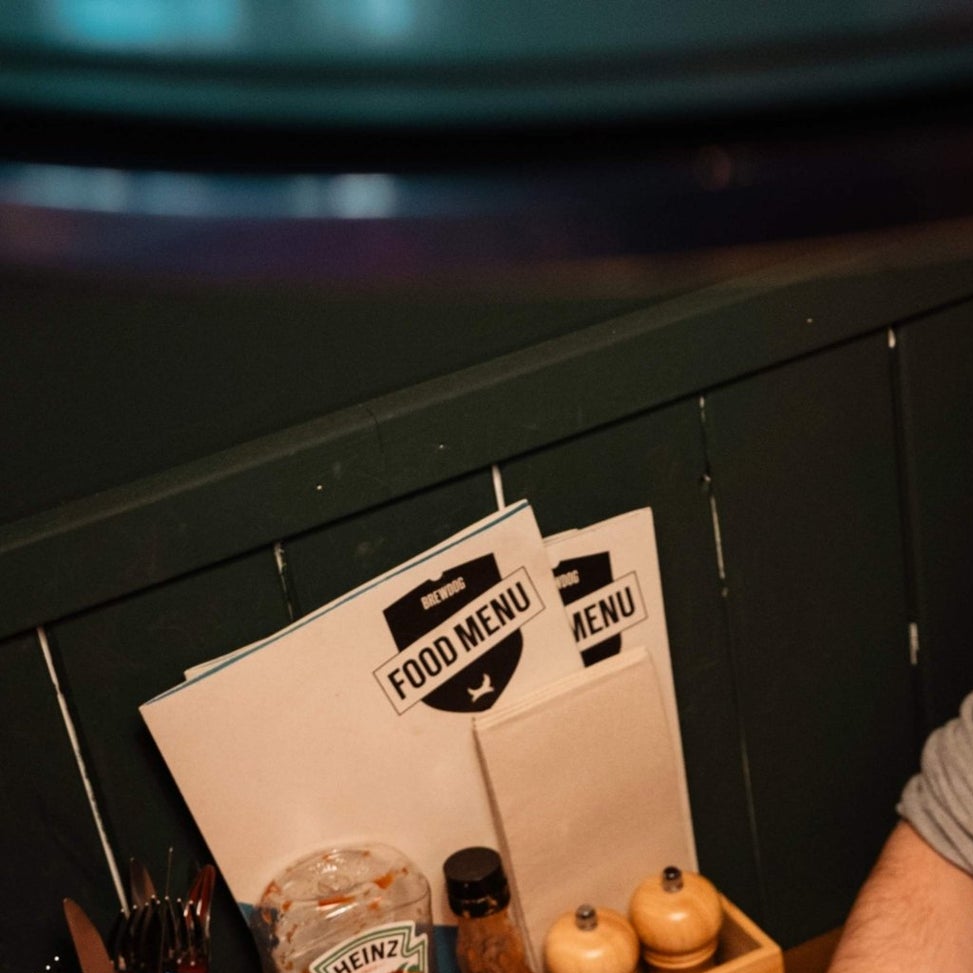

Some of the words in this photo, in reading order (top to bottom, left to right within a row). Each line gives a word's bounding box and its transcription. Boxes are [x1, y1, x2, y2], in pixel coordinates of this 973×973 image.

[420, 576, 466, 610] BREWDOG
[387, 635, 458, 700] FOOD
[453, 581, 531, 653] MENU
